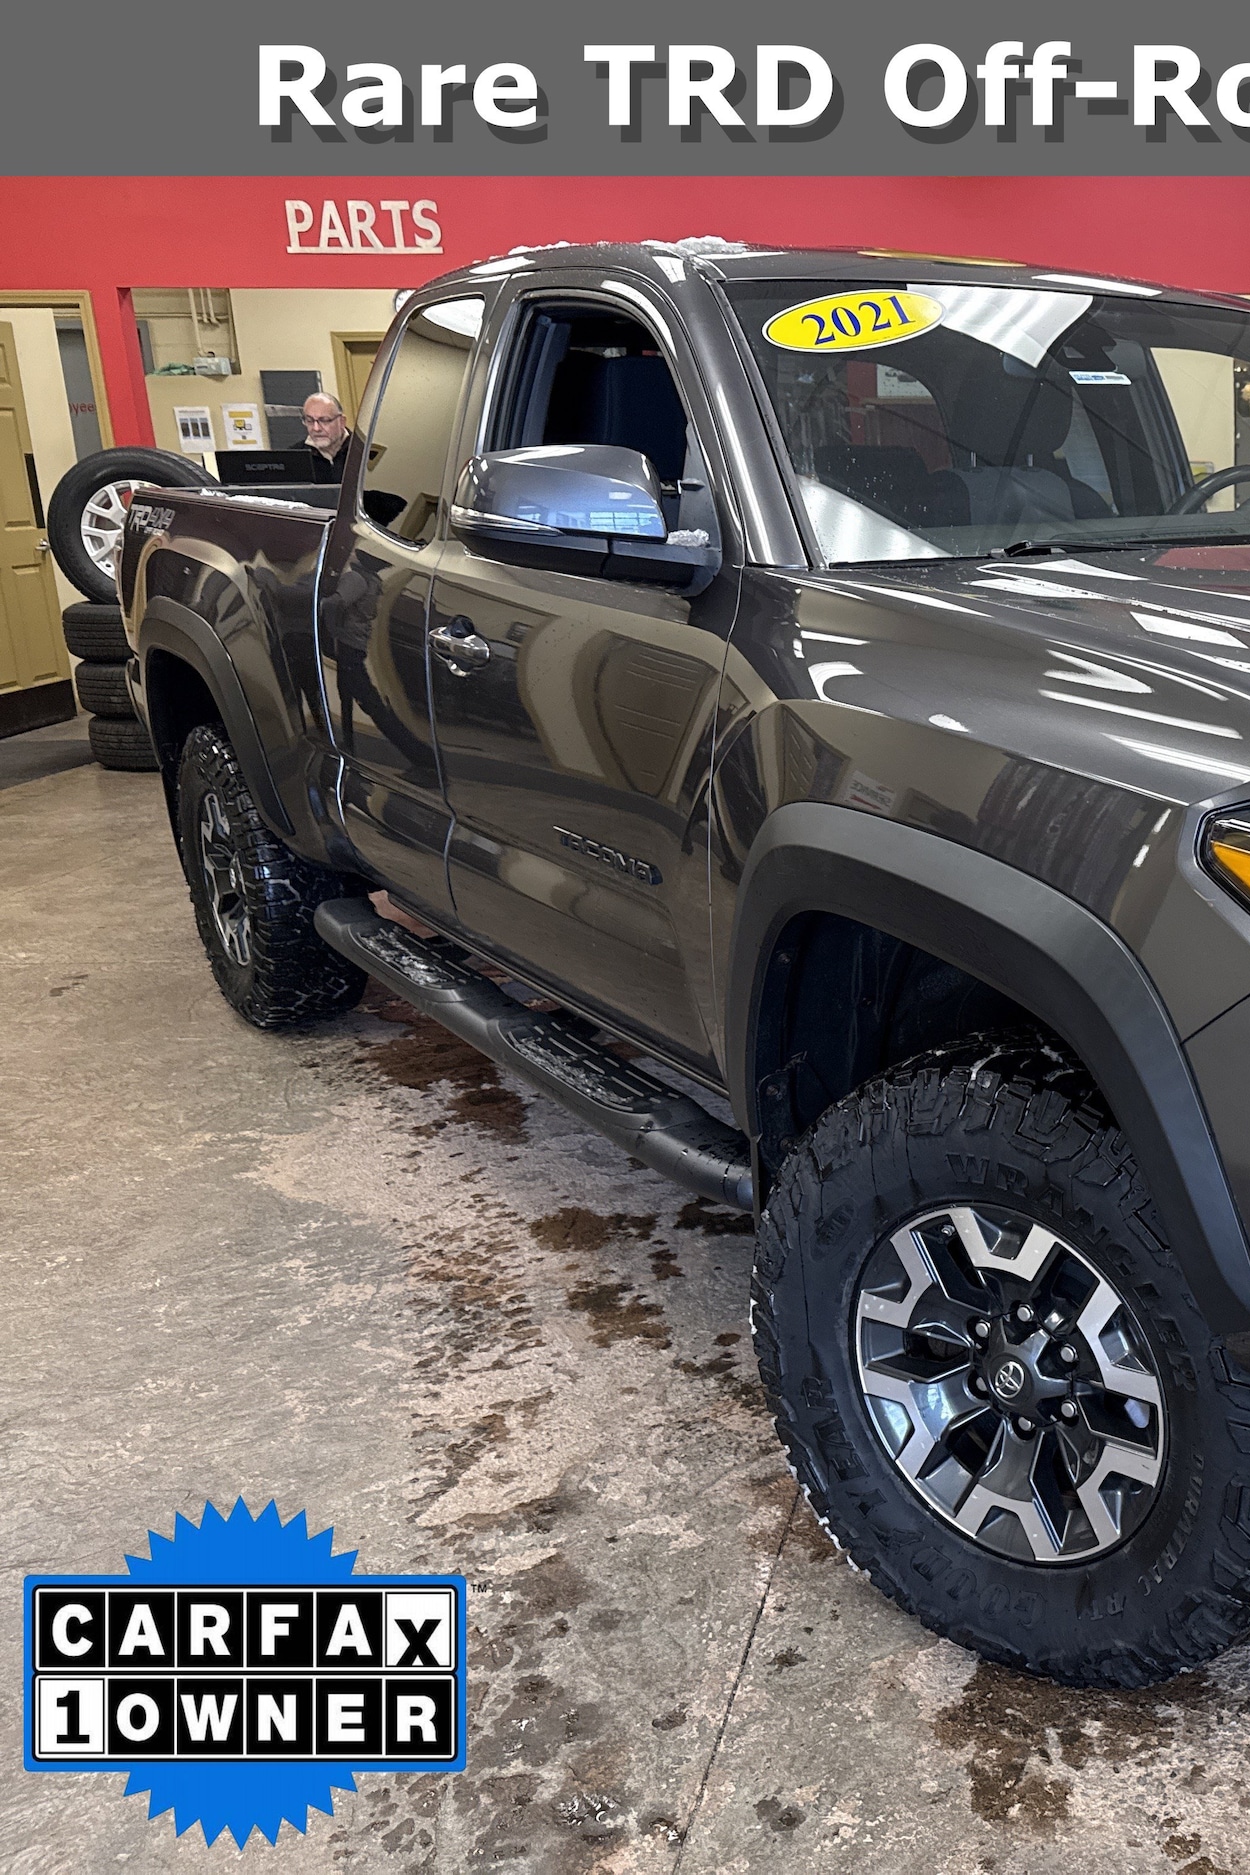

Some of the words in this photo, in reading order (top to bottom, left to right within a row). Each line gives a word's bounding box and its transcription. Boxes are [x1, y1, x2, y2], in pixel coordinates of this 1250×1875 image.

[284, 198, 444, 252] PARTS
[801, 294, 916, 346] 2021
[69, 402, 97, 417] yee
[128, 503, 153, 532] TRD
[553, 825, 663, 886] TACOMA
[944, 1152, 1199, 1393] WRANGLER
[801, 1375, 1049, 1630] GOODYEAR
[1137, 1452, 1205, 1597] DURATRAC
